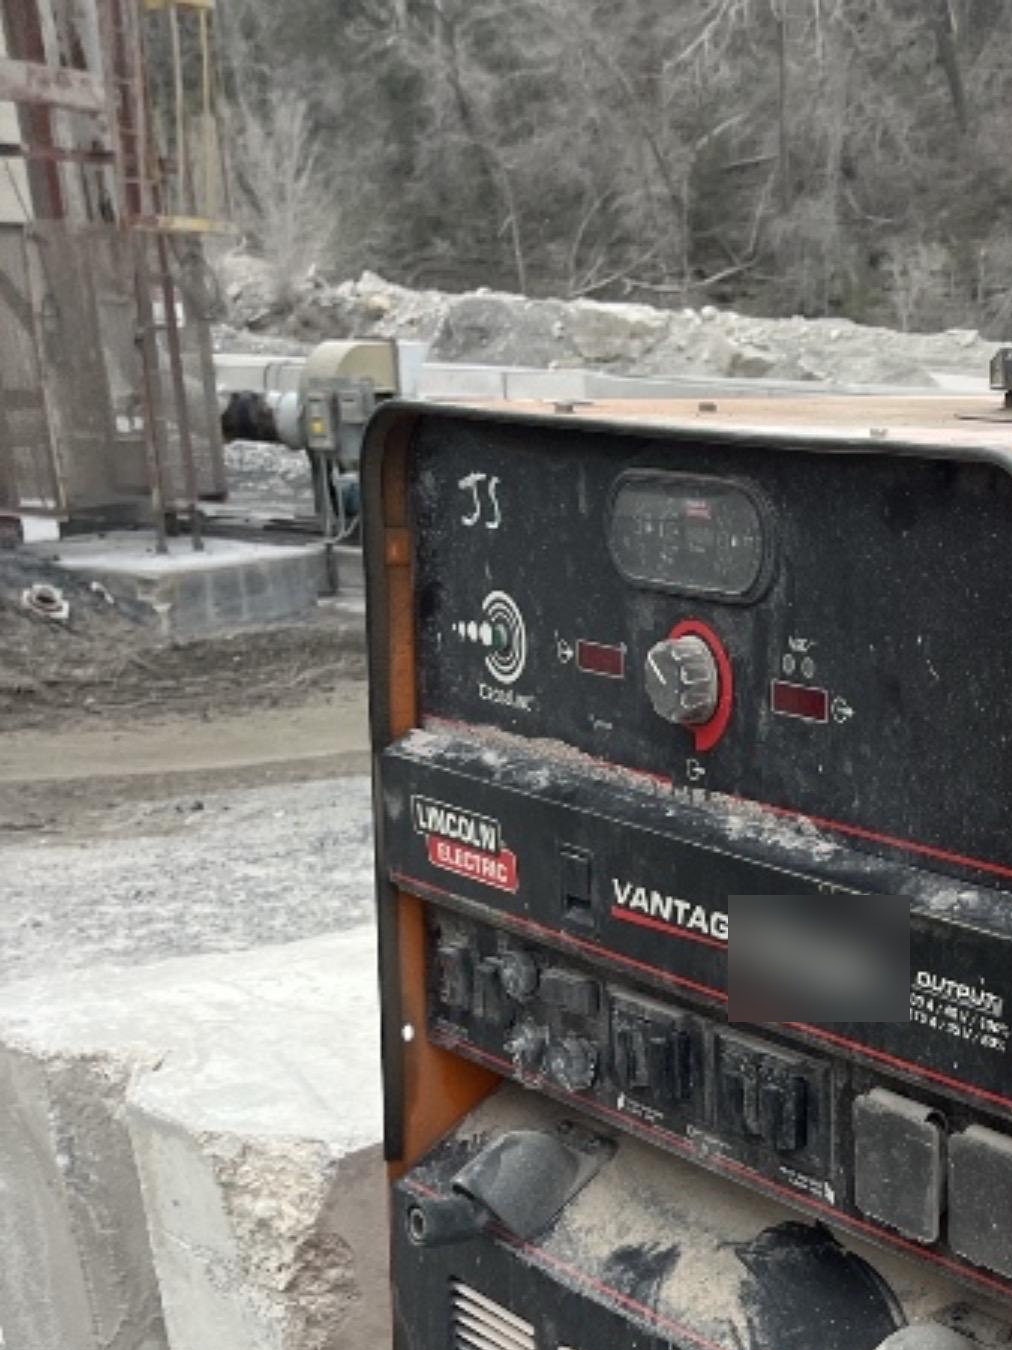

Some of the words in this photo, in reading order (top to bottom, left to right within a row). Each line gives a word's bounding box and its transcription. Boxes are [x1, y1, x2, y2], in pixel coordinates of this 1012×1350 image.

[415, 800, 497, 853] LINCOLN
[436, 841, 509, 884] ELECTRIC
[611, 877, 728, 940] VANTAG
